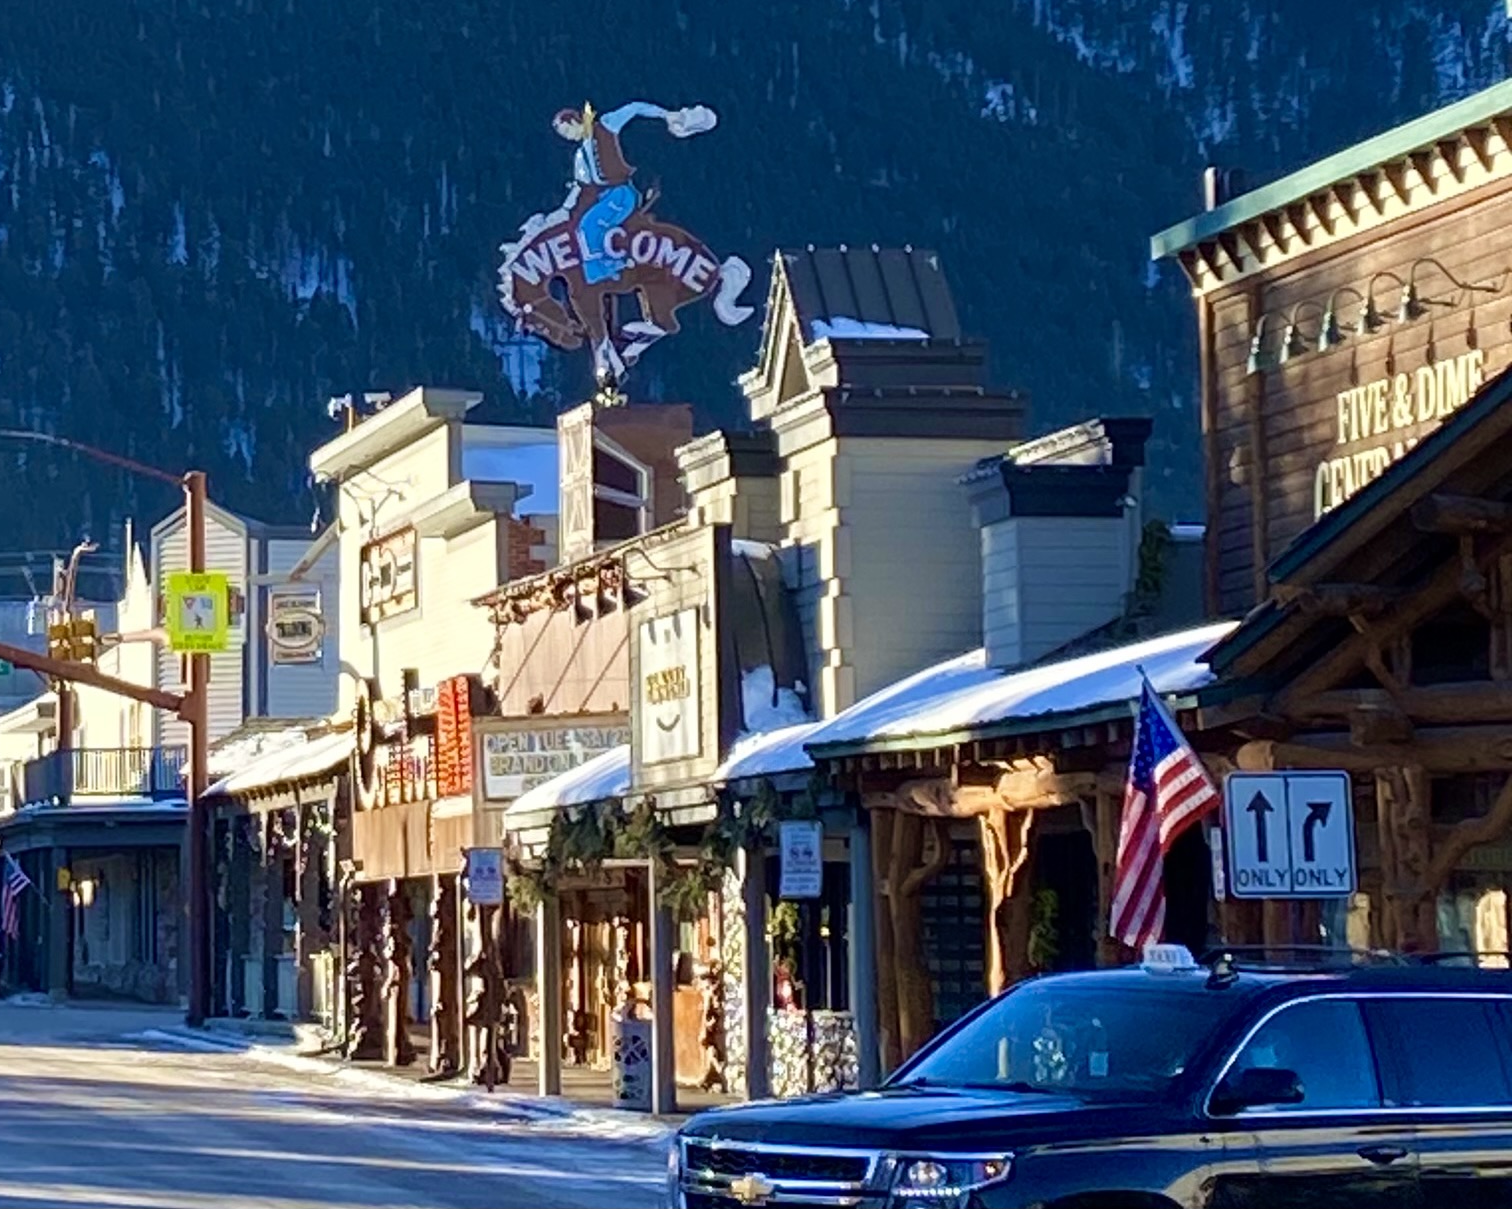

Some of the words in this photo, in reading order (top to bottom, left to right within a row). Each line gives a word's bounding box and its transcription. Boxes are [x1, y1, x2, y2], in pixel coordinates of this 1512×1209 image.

[512, 227, 717, 292] WELCOME
[1337, 379, 1389, 444] FIVE
[1392, 373, 1414, 428] &
[1416, 349, 1483, 422] DIME
[488, 732, 529, 754] OPEN
[1238, 868, 1288, 887] ONLY
[1295, 868, 1348, 887] ONLY
